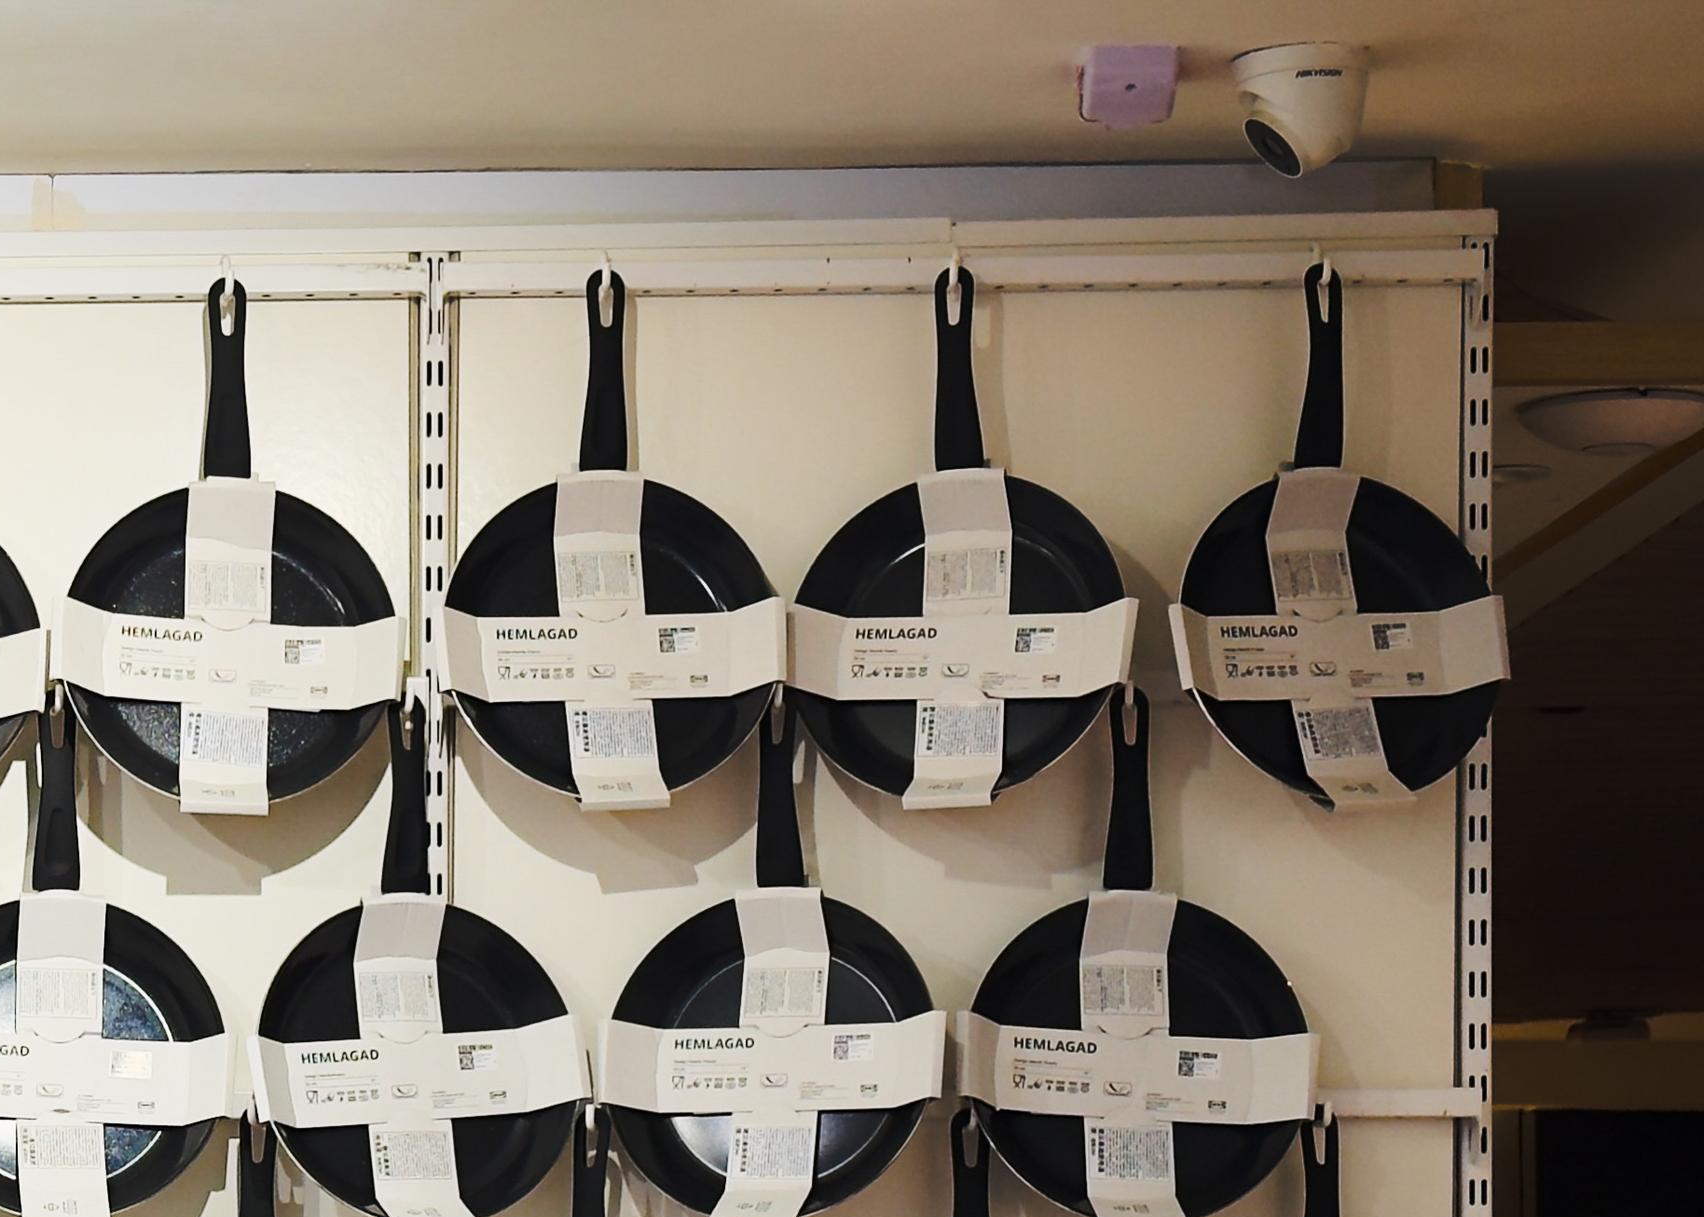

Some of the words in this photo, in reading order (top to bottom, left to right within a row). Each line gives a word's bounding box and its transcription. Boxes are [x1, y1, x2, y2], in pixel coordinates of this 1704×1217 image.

[121, 625, 203, 642] HEMLAGAD
[496, 628, 578, 640] HEMLAGAD
[855, 627, 938, 640] HEMLAGAD
[1220, 625, 1299, 638] HEMLAGAD
[674, 1037, 755, 1050] HEMLAGAD
[1013, 1036, 1097, 1054] HEMLAGAD
[301, 1049, 380, 1064] HEMLAGAD
